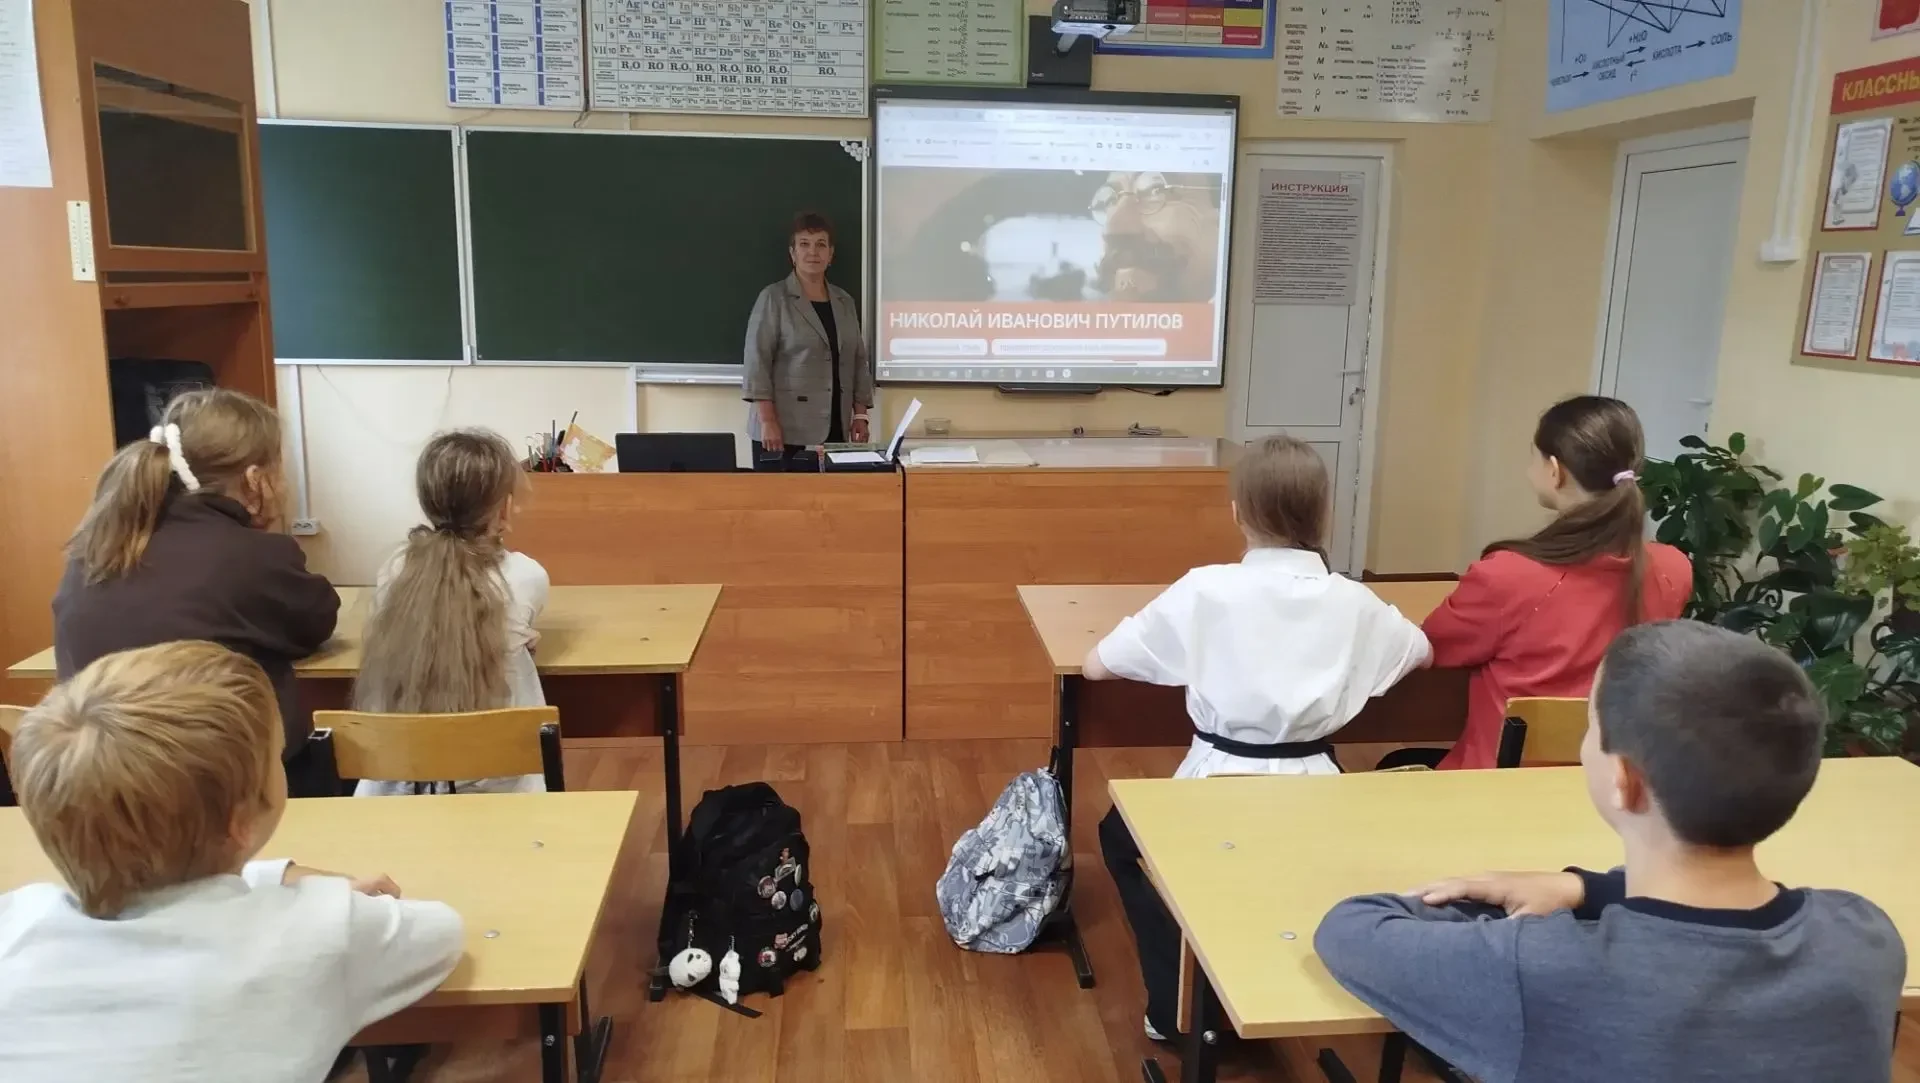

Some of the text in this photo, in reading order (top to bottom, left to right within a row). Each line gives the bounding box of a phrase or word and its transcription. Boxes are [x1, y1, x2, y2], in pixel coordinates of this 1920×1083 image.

[595, 24, 604, 32] VI
[619, 15, 632, 23] Cs
[644, 16, 657, 24] Ba
[768, 20, 782, 28] Re
[793, 21, 806, 29] Os
[593, 46, 606, 54] VII
[620, 45, 631, 53] Fr
[645, 46, 660, 54] Ra
[744, 49, 756, 58] Sg
[648, 62, 664, 70] RO
[1271, 182, 1348, 193] ИНСТРУКЦИЯ
[890, 309, 1184, 330] НИКОЛАЙ ИВАНОВИЧ ПУТИЛОВ
